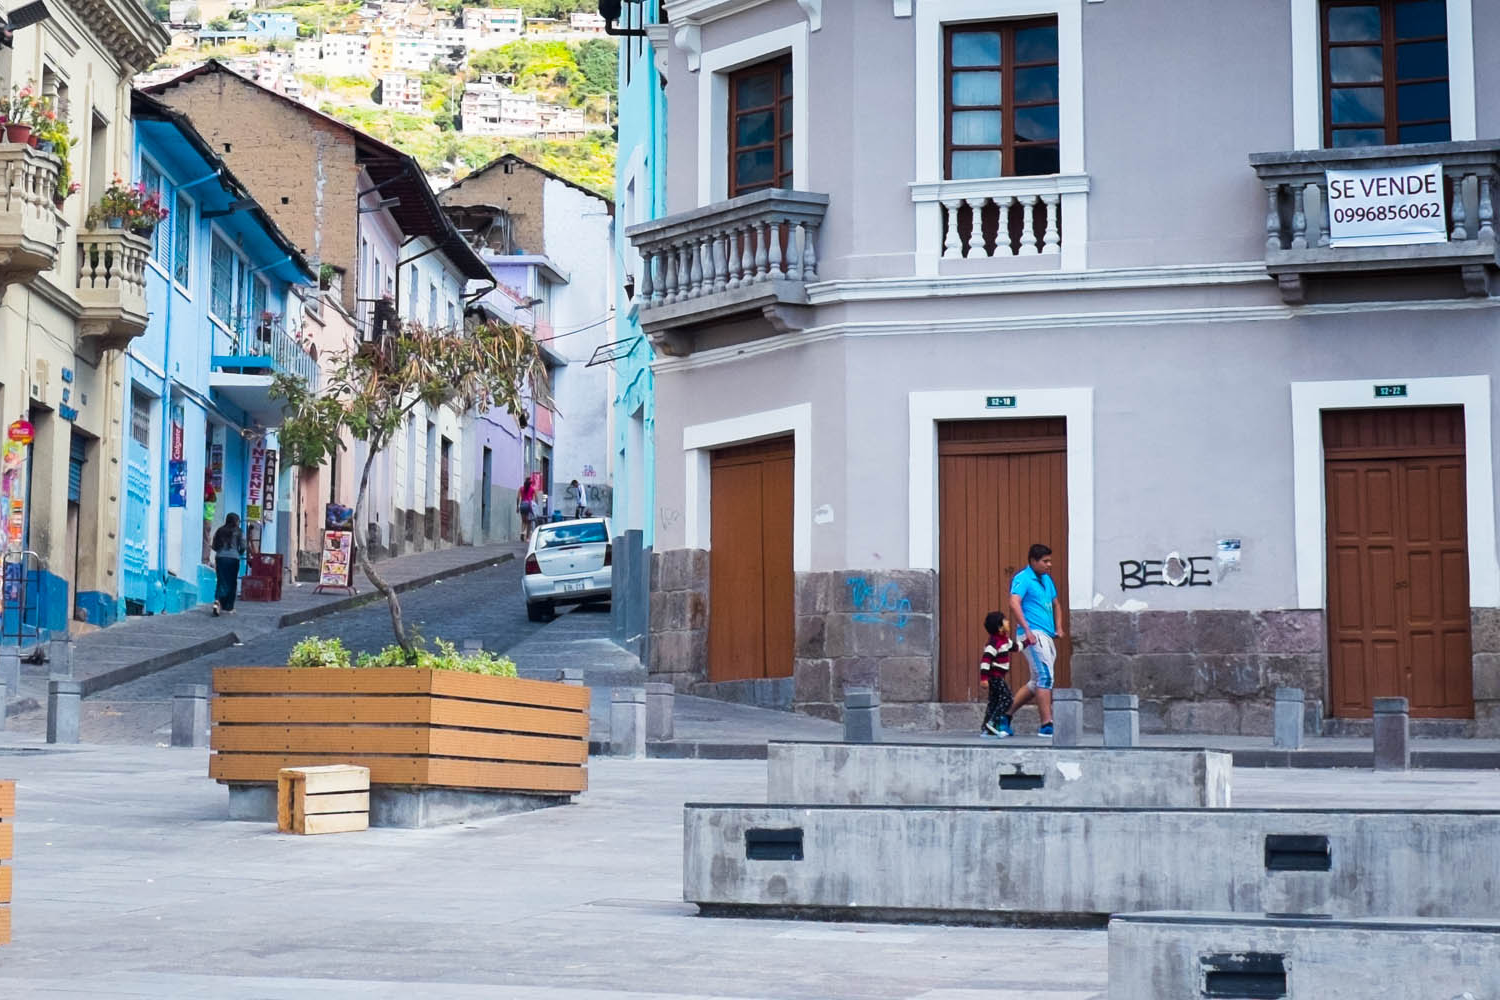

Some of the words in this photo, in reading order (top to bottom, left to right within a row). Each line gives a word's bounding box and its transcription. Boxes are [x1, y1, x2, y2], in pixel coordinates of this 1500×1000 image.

[1329, 179, 1355, 200] SE
[1359, 173, 1437, 198] VENDE
[1333, 202, 1441, 224] 0996856062
[173, 428, 182, 460] Colgate
[248, 440, 265, 506] INTERNET
[265, 450, 276, 510] CABINAS
